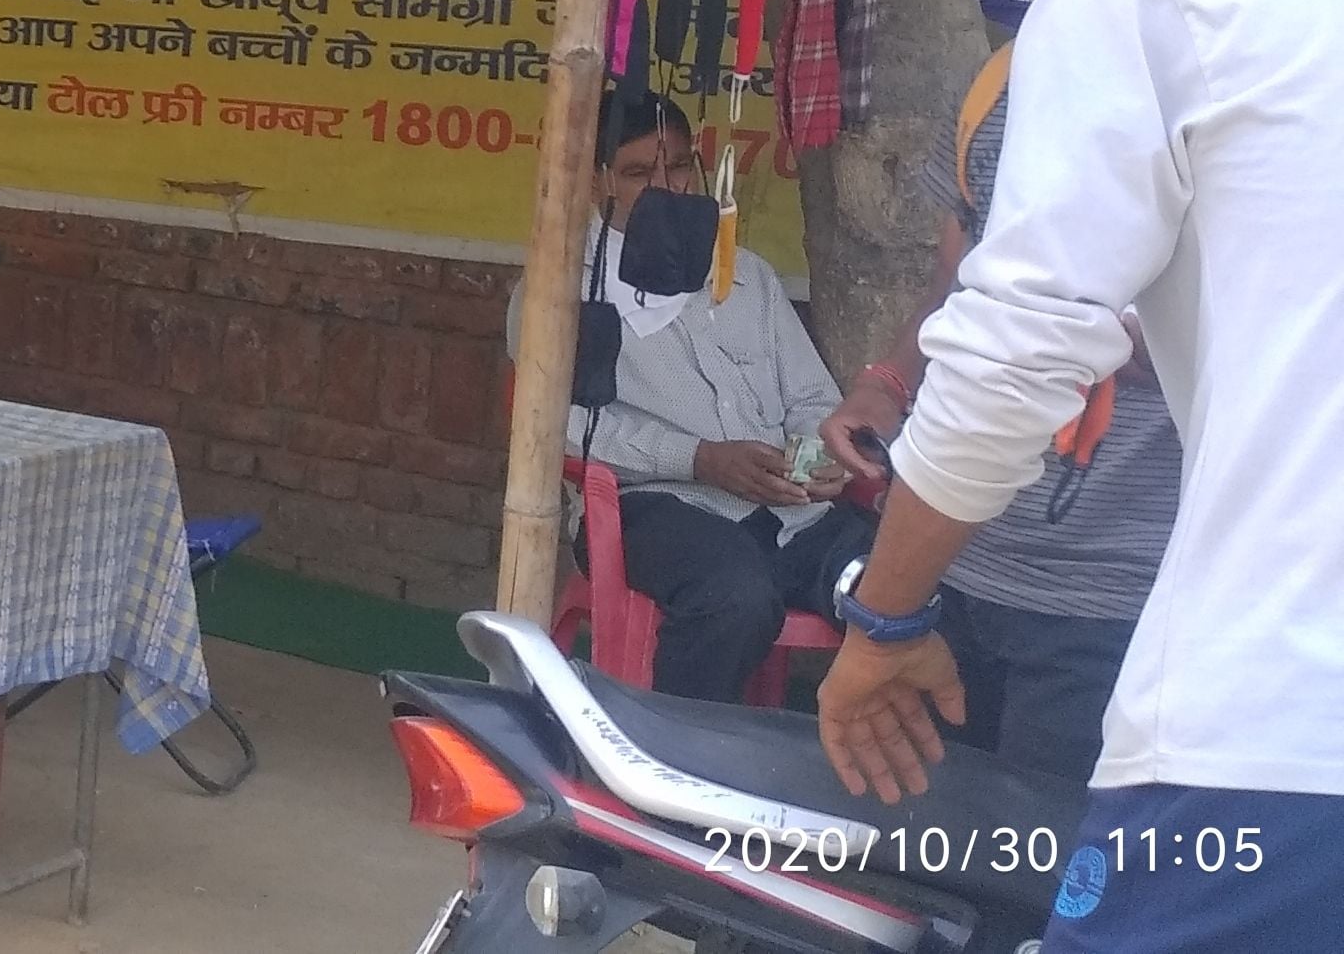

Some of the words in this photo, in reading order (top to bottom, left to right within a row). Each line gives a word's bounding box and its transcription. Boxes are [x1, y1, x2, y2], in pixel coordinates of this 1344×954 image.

[87, 17, 197, 58] अपने
[206, 23, 320, 66] बच्चों
[325, 29, 377, 70] के
[46, 75, 134, 120] टोल
[218, 97, 350, 142] नम्बर
